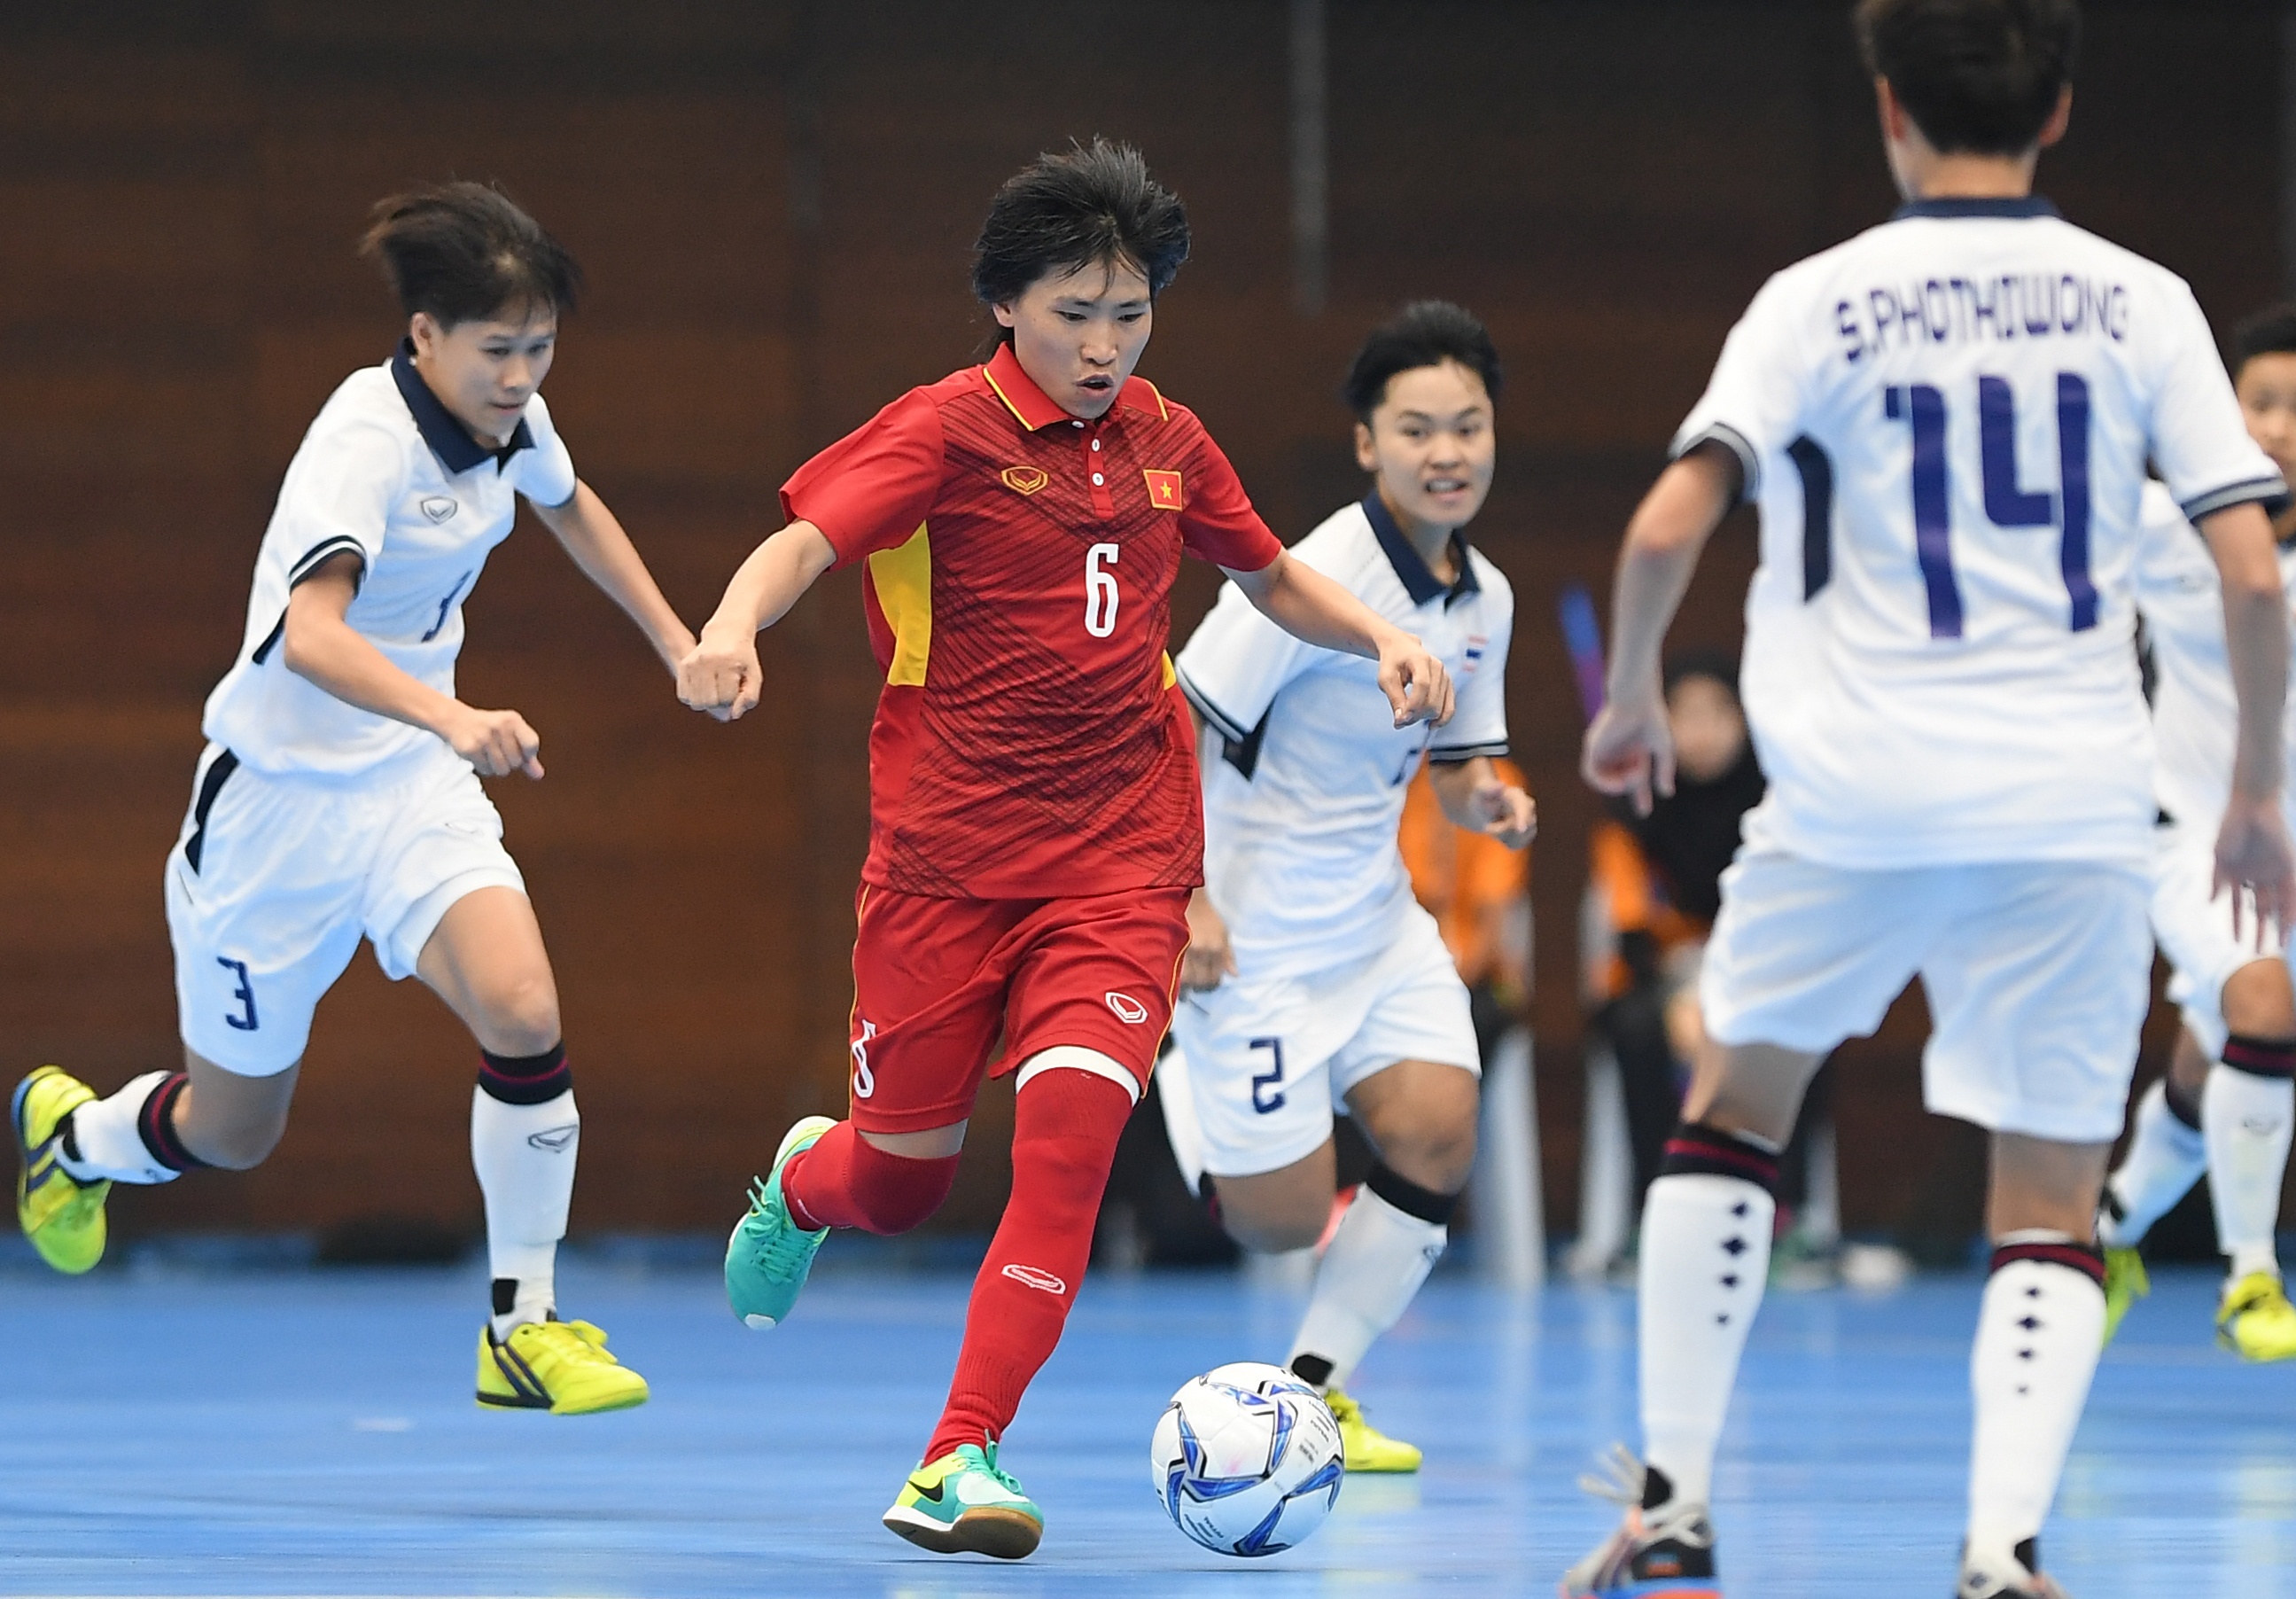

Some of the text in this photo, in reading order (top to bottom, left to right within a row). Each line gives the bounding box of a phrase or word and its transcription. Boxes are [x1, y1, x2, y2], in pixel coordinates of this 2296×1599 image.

[1836, 276, 2126, 361] S.PHOTHIWONG
[1885, 371, 2100, 640] 14
[1084, 542, 1119, 638] 6
[216, 956, 259, 1032] 3
[852, 1018, 876, 1098] 6
[1249, 1037, 1285, 1114] 2
